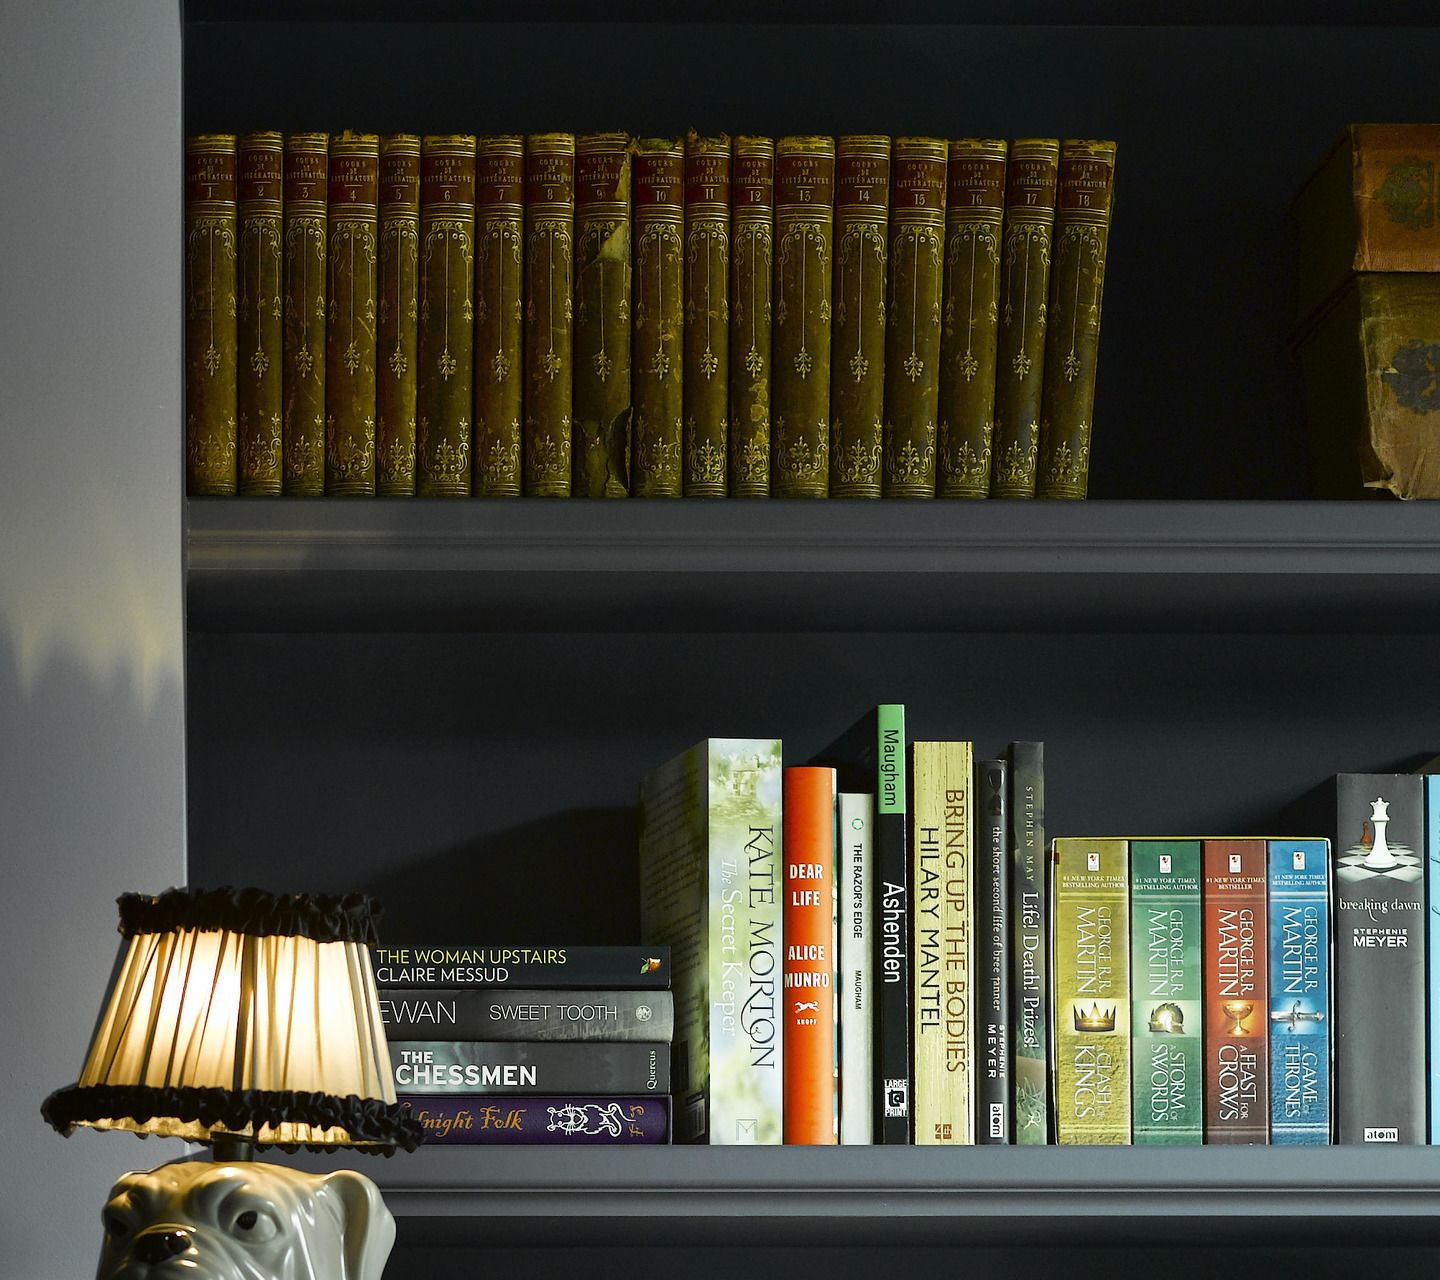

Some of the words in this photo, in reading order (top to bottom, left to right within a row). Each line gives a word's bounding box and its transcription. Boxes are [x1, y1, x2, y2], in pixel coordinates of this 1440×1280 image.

[656, 191, 666, 201] 10
[749, 191, 761, 202] 12
[799, 191, 810, 201] 13
[882, 729, 900, 806] Maugham
[945, 790, 965, 869] BRING
[1026, 786, 1034, 846] STEPHEN
[749, 824, 775, 908] KATE
[790, 864, 823, 879] DEAR
[920, 827, 940, 919] HILARY
[793, 891, 820, 906] LIFE
[945, 880, 965, 912] UP
[1022, 892, 1039, 929] Life!
[1340, 898, 1388, 921] breaking
[1391, 899, 1421, 911] dawn
[376, 950, 409, 964] THE
[415, 949, 486, 963] WOMAN
[490, 949, 566, 964] UPSTAIRS
[788, 946, 824, 961] ALICE
[883, 882, 905, 983] Ashenden
[945, 921, 966, 971] THE
[1077, 907, 1096, 993] MARTIN
[1098, 907, 1111, 962] GEORGE
[1148, 909, 1168, 996] MARTIN
[1170, 910, 1183, 966] GEORGE
[1218, 909, 1239, 996] MARTIN
[1240, 909, 1253, 965] GEORGE
[1283, 907, 1302, 993] MARTIN
[1304, 907, 1318, 962] GEORGE
[1353, 936, 1408, 947] MEYER
[377, 968, 435, 982] CLAIRE
[441, 968, 509, 982] MESSUD
[785, 973, 829, 988] MUNRO
[920, 929, 941, 1035] MANTEL
[1023, 934, 1040, 990] Death!
[489, 1005, 551, 1021] SWEET
[558, 1006, 617, 1021] TOOTH
[741, 921, 775, 1069] MORTON
[1023, 996, 1040, 1048] Prizes!
[946, 981, 966, 1072] BODIES
[987, 1024, 997, 1078] MEYER
[396, 1065, 536, 1086] CHESSMEN
[401, 1051, 432, 1064] THE
[647, 1050, 657, 1089] Quercus
[1074, 1045, 1096, 1118] KINGS
[1151, 1044, 1169, 1121] SWORDS
[1170, 1052, 1186, 1109] STORM
[1218, 1045, 1239, 1121] CROWS
[1240, 1054, 1257, 1102] FEAST
[1284, 1042, 1301, 1118] THRONES
[480, 1106, 527, 1130] Folk
